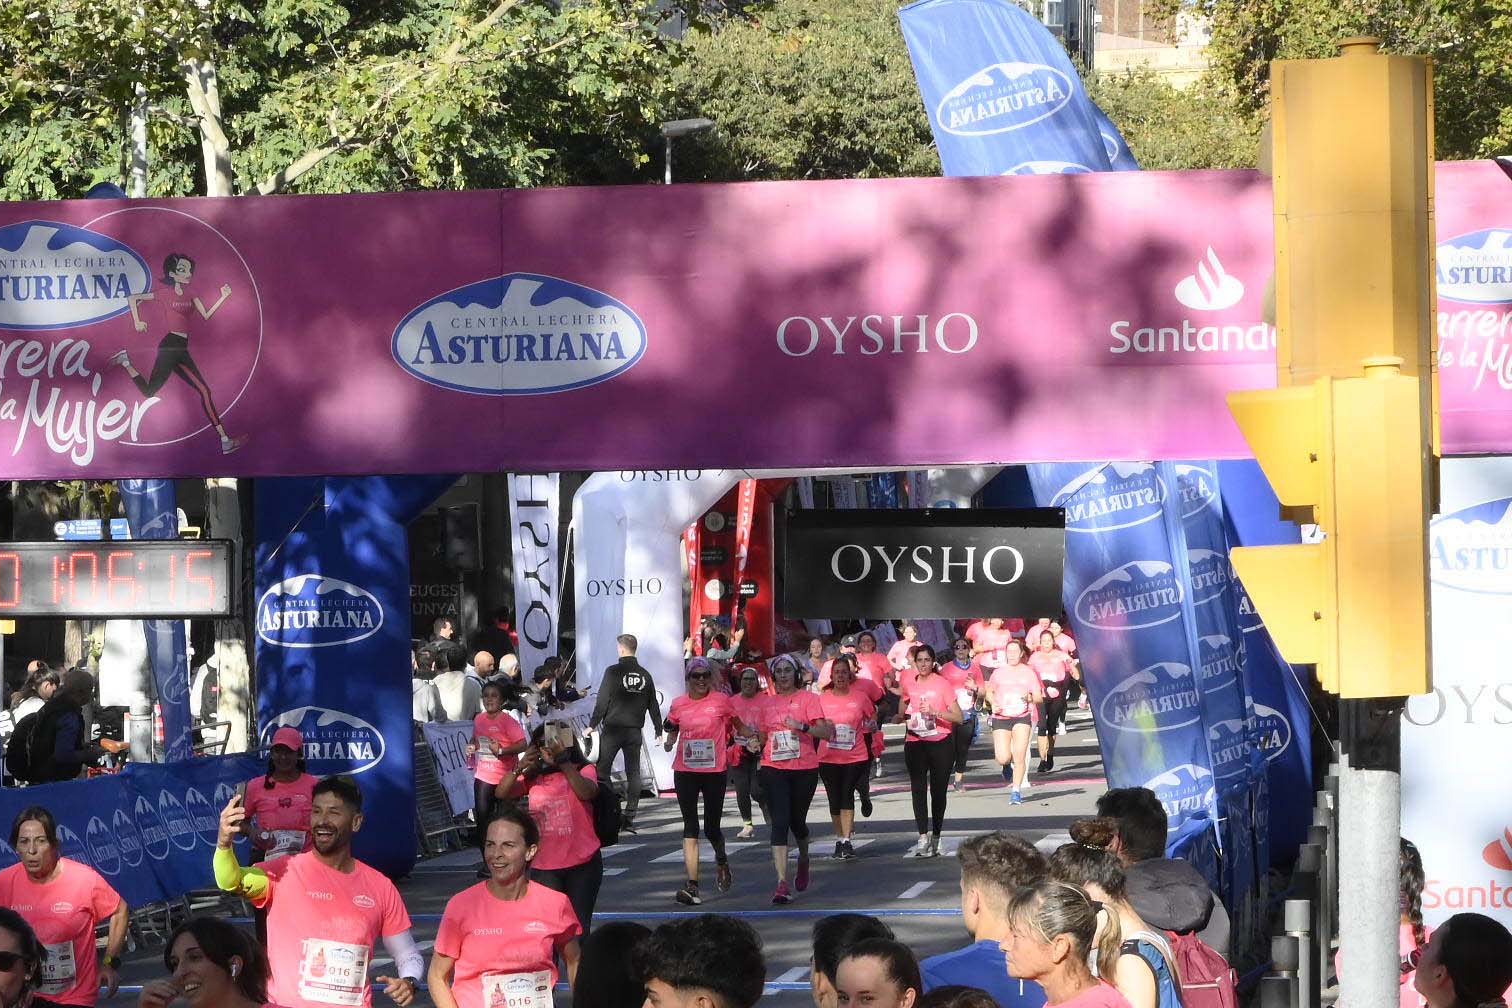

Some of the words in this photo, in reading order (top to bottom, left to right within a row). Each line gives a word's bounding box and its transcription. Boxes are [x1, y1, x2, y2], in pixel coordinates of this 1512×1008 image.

[54, 257, 127, 269] LECHERA
[451, 316, 529, 329] CENTRAL
[538, 313, 619, 327] LECHERA
[776, 312, 979, 357] OYSHO
[1109, 320, 1277, 354] Santand
[1437, 309, 1512, 339] arrer
[411, 320, 627, 366] ASTURIANA
[1472, 337, 1512, 391] Mu
[11, 372, 163, 467] Mujer
[830, 544, 1024, 585] OYSHO
[587, 577, 663, 597] OYSHO
[260, 604, 374, 632] ASTURIANA
[1403, 684, 1512, 727] OYS
[328, 967, 351, 977] 016
